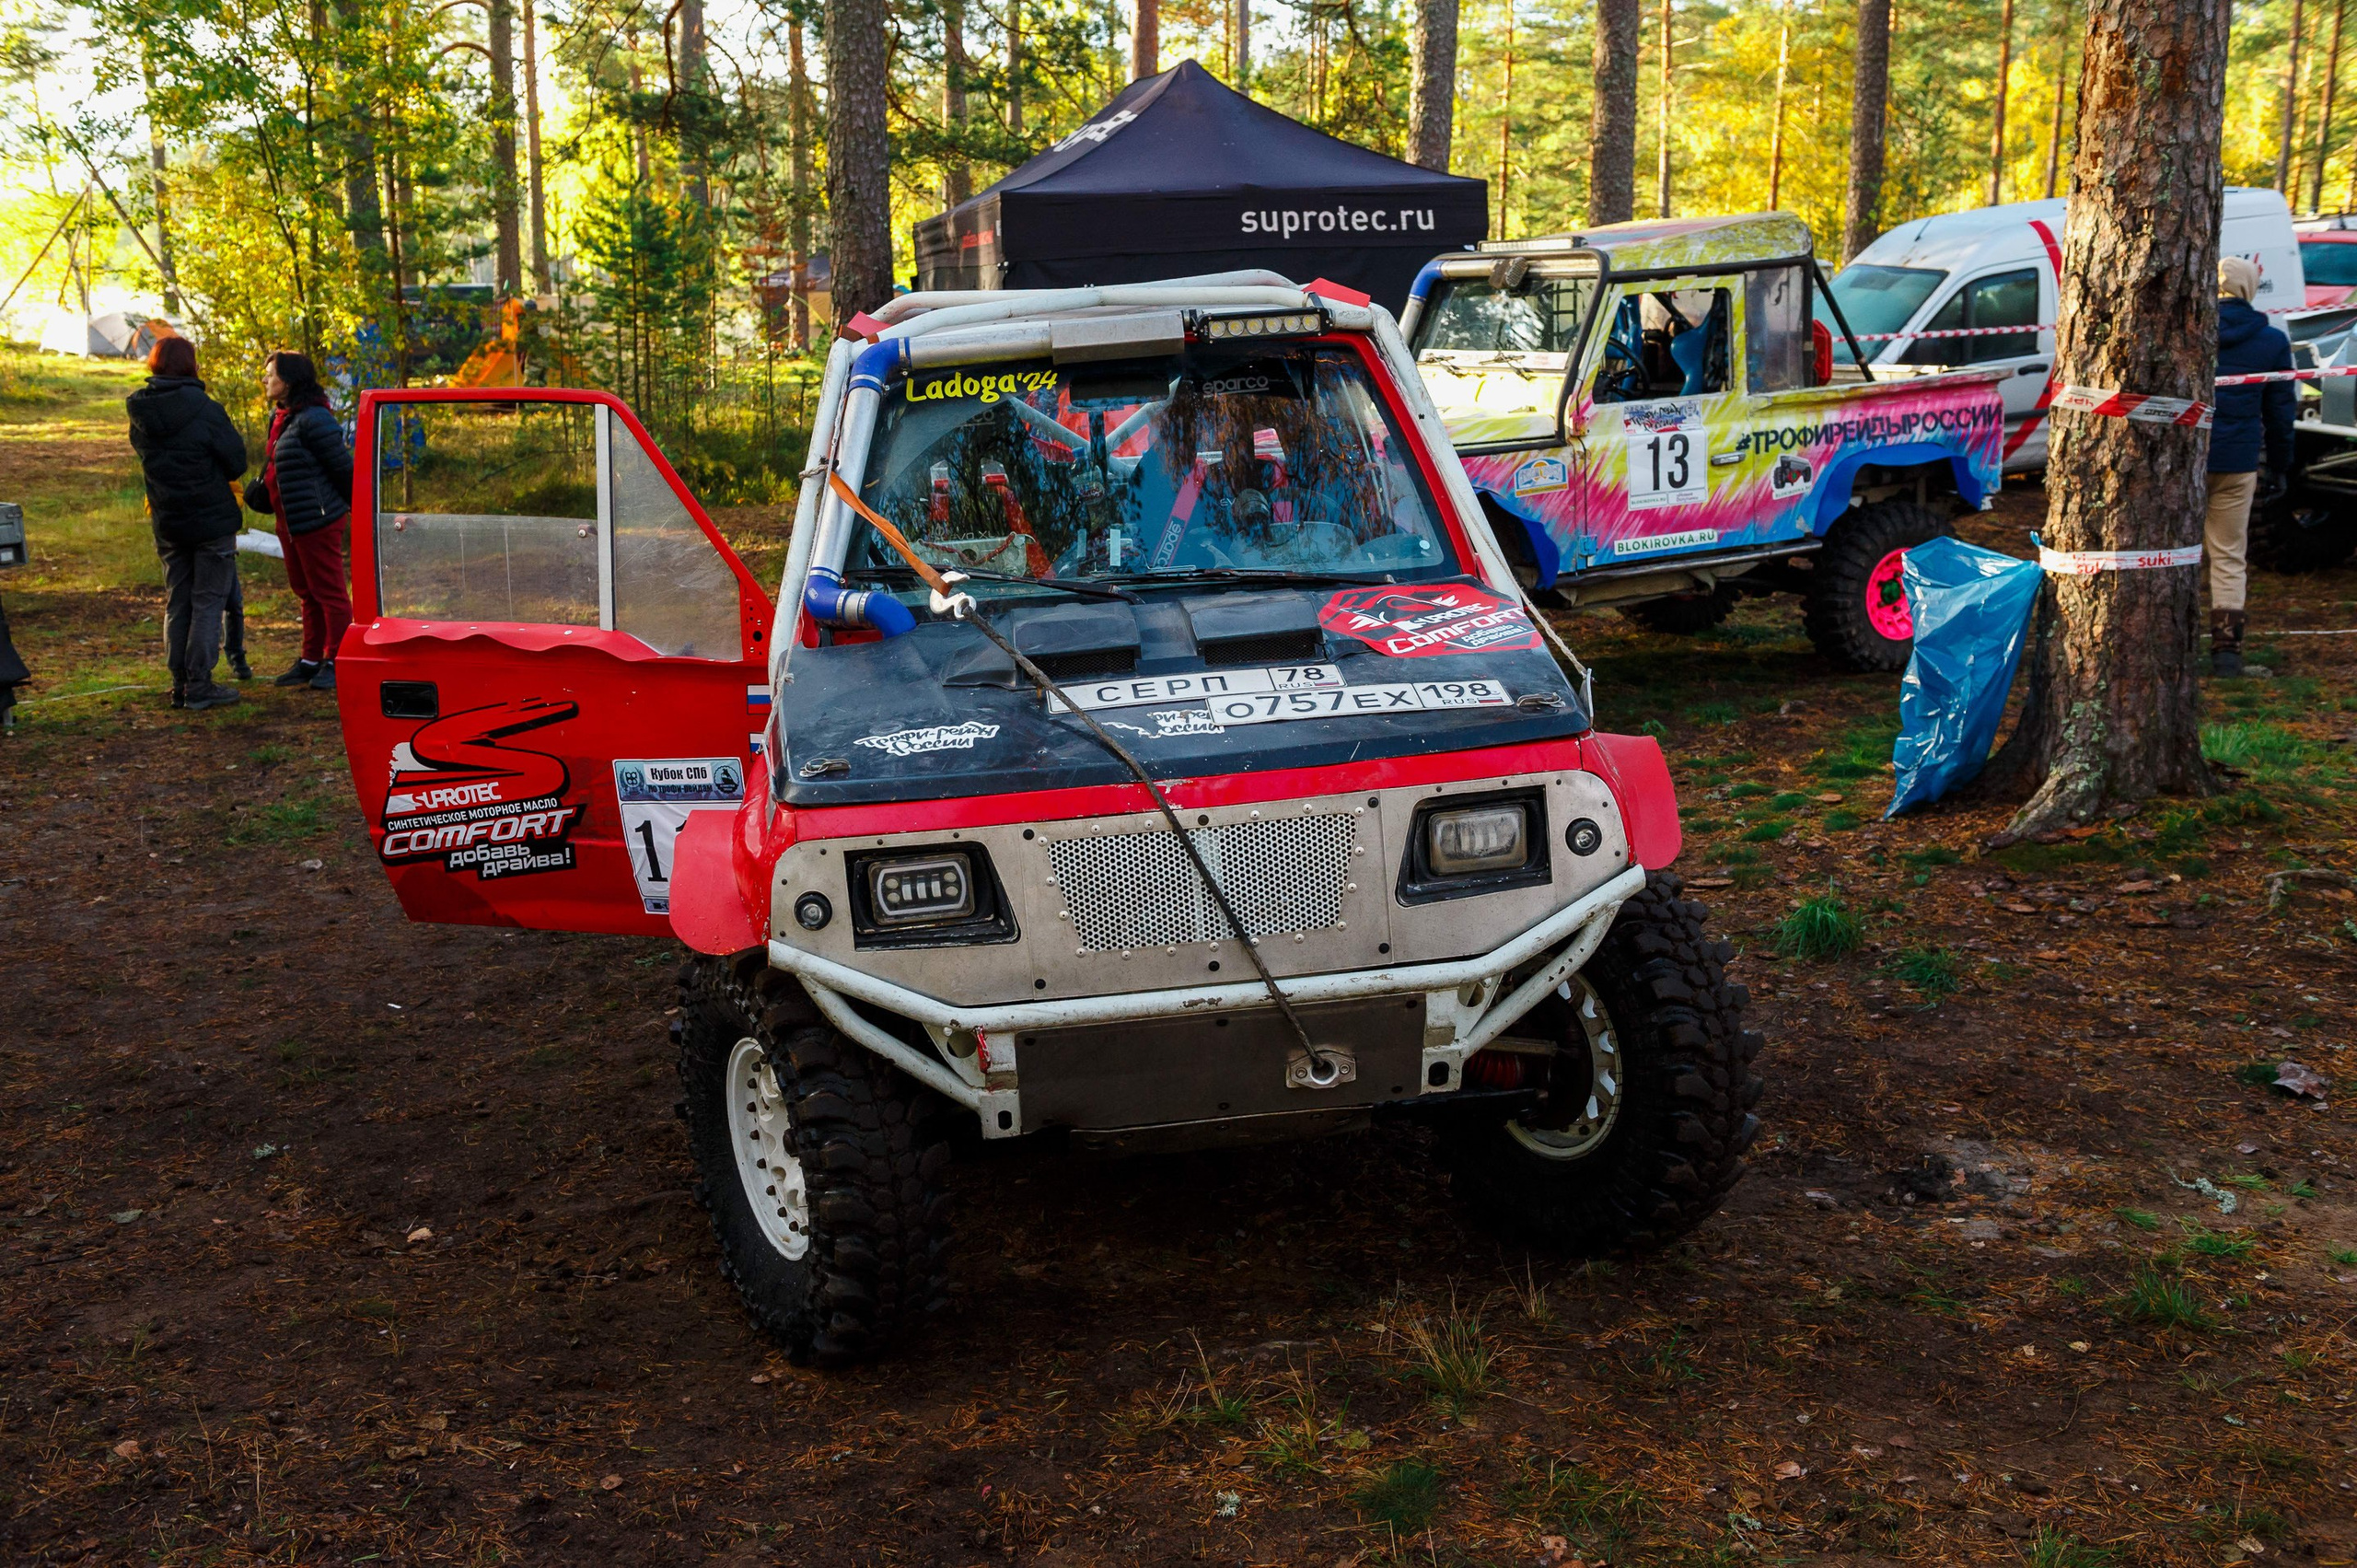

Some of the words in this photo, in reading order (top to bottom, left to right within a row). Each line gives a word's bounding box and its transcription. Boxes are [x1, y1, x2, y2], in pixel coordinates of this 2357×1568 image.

[1240, 205, 1434, 239] suprotec.ru
[905, 369, 1058, 403] Ladoga'24
[1202, 376, 1269, 396] sparco
[1646, 434, 1689, 491] 13
[1156, 523, 1182, 567] sparc
[1617, 530, 1715, 553] BLOKIROVKA.RU
[1387, 607, 1526, 654] COMFORT
[1096, 676, 1228, 703] СЕРП
[1278, 668, 1325, 682] 78
[1422, 682, 1492, 699] 198
[650, 768, 684, 781] Кубок
[686, 767, 708, 779] СПб
[412, 782, 502, 810] SUPROTEC
[388, 811, 468, 831] СИНТЕТИЧЕСКОЕ
[469, 802, 522, 820] МОТОРНОЕ
[522, 797, 558, 812] МАСЛО
[383, 808, 574, 855] COMFORT
[449, 844, 530, 868] добавь
[482, 847, 571, 877] драйва!
